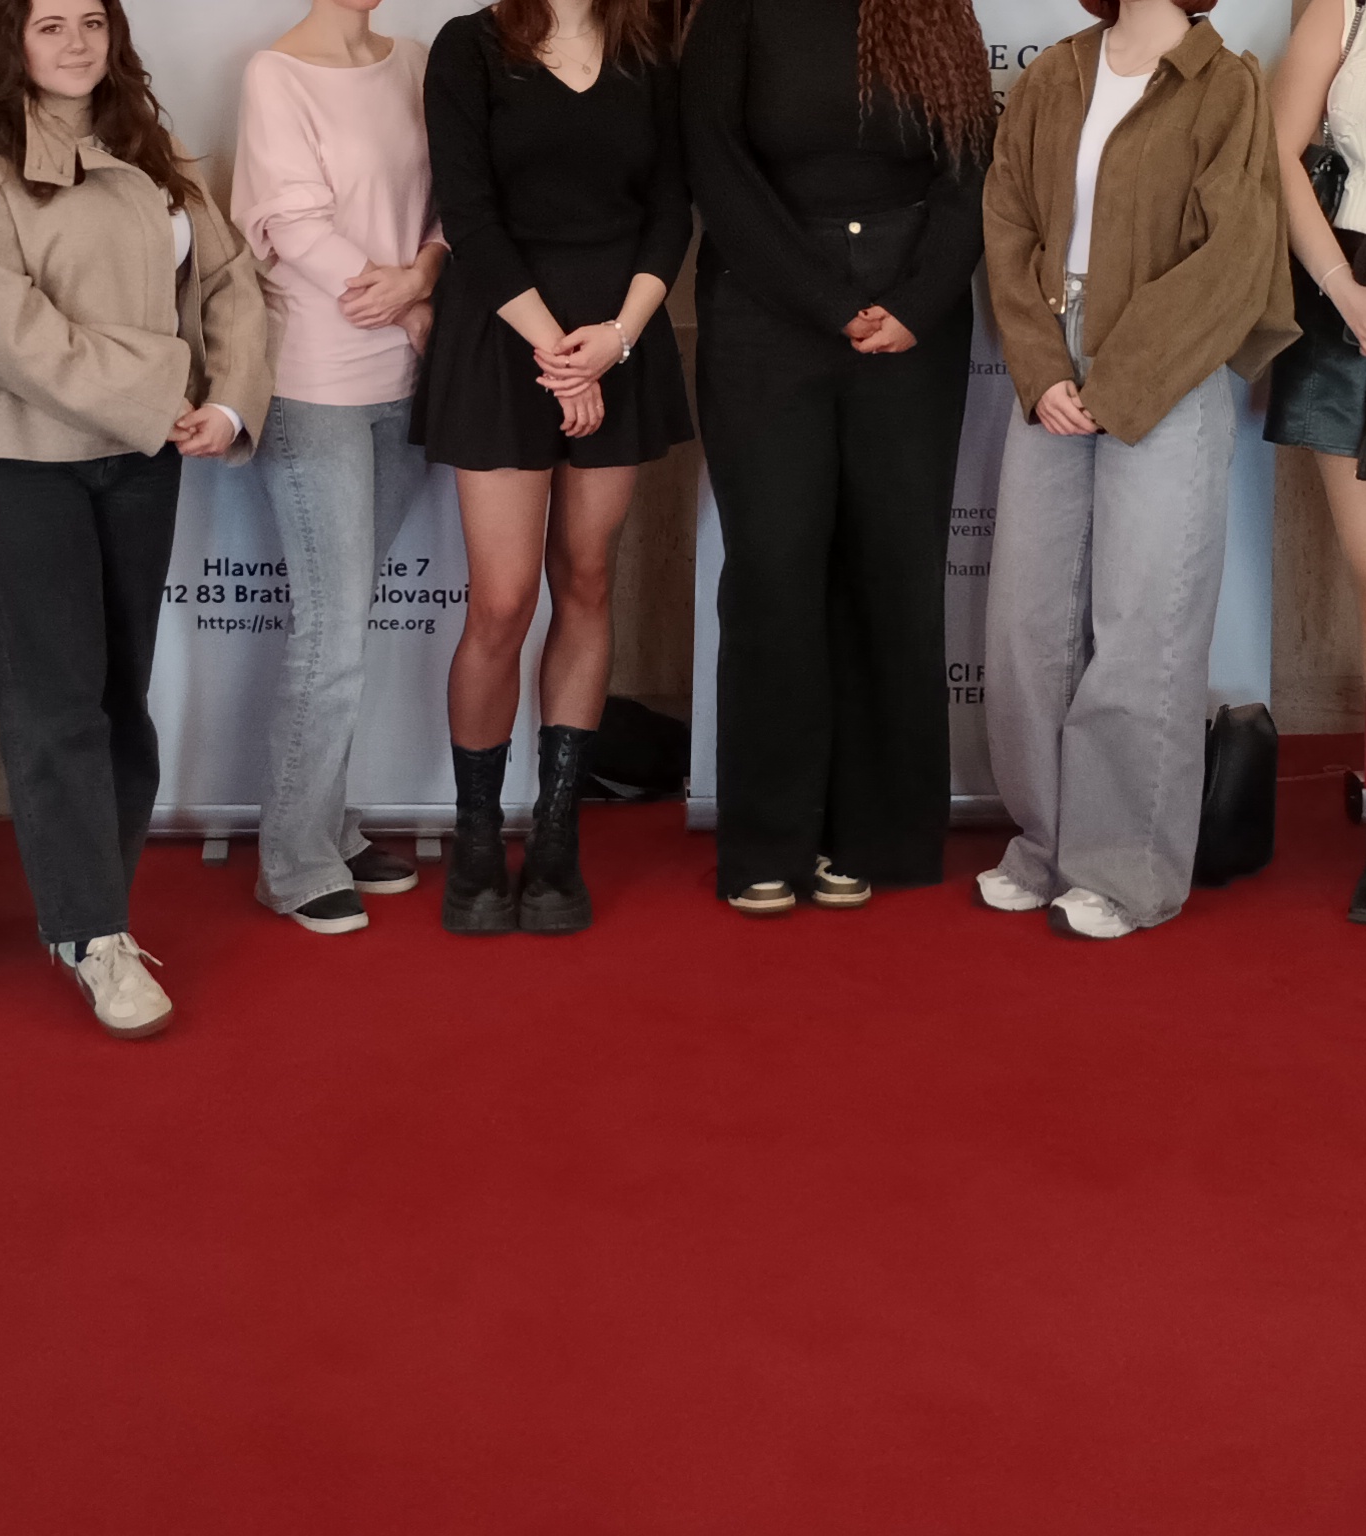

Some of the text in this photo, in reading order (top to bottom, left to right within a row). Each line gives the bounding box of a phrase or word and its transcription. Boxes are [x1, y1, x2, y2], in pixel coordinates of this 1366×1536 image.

[203, 557, 288, 577] Hlavné
[416, 558, 430, 577] 7
[164, 585, 188, 603] 12
[196, 584, 226, 604] 83
[235, 583, 291, 604] Brati
